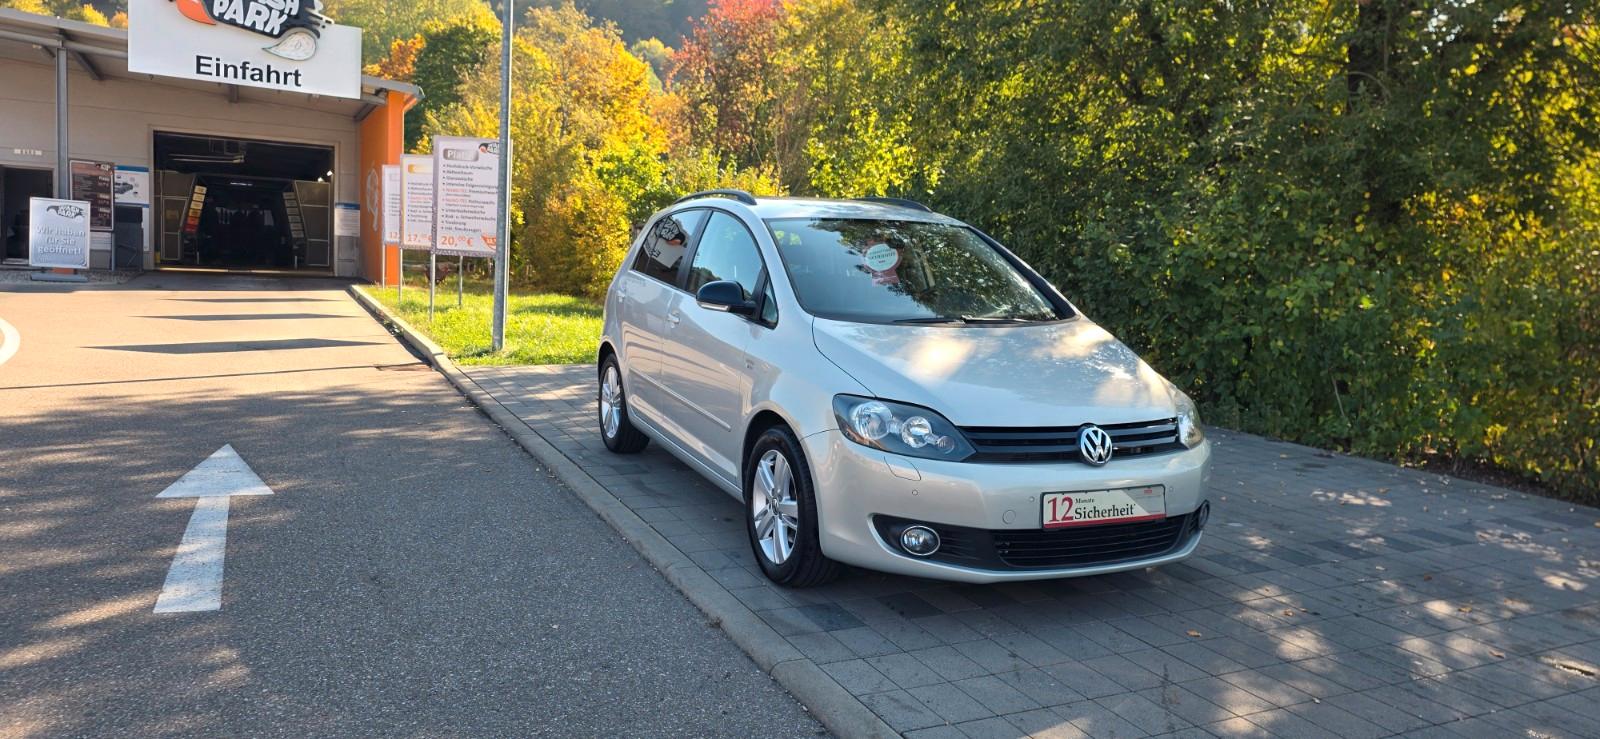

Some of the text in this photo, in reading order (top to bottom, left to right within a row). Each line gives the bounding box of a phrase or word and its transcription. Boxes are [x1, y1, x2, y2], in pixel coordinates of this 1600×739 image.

[213, 0, 288, 36] PARK
[195, 54, 302, 87] Einfahrt
[56, 226, 86, 238] haben
[38, 245, 81, 255] geöffnet!
[1047, 496, 1074, 523] 12
[1074, 503, 1135, 520] Sicherheit
